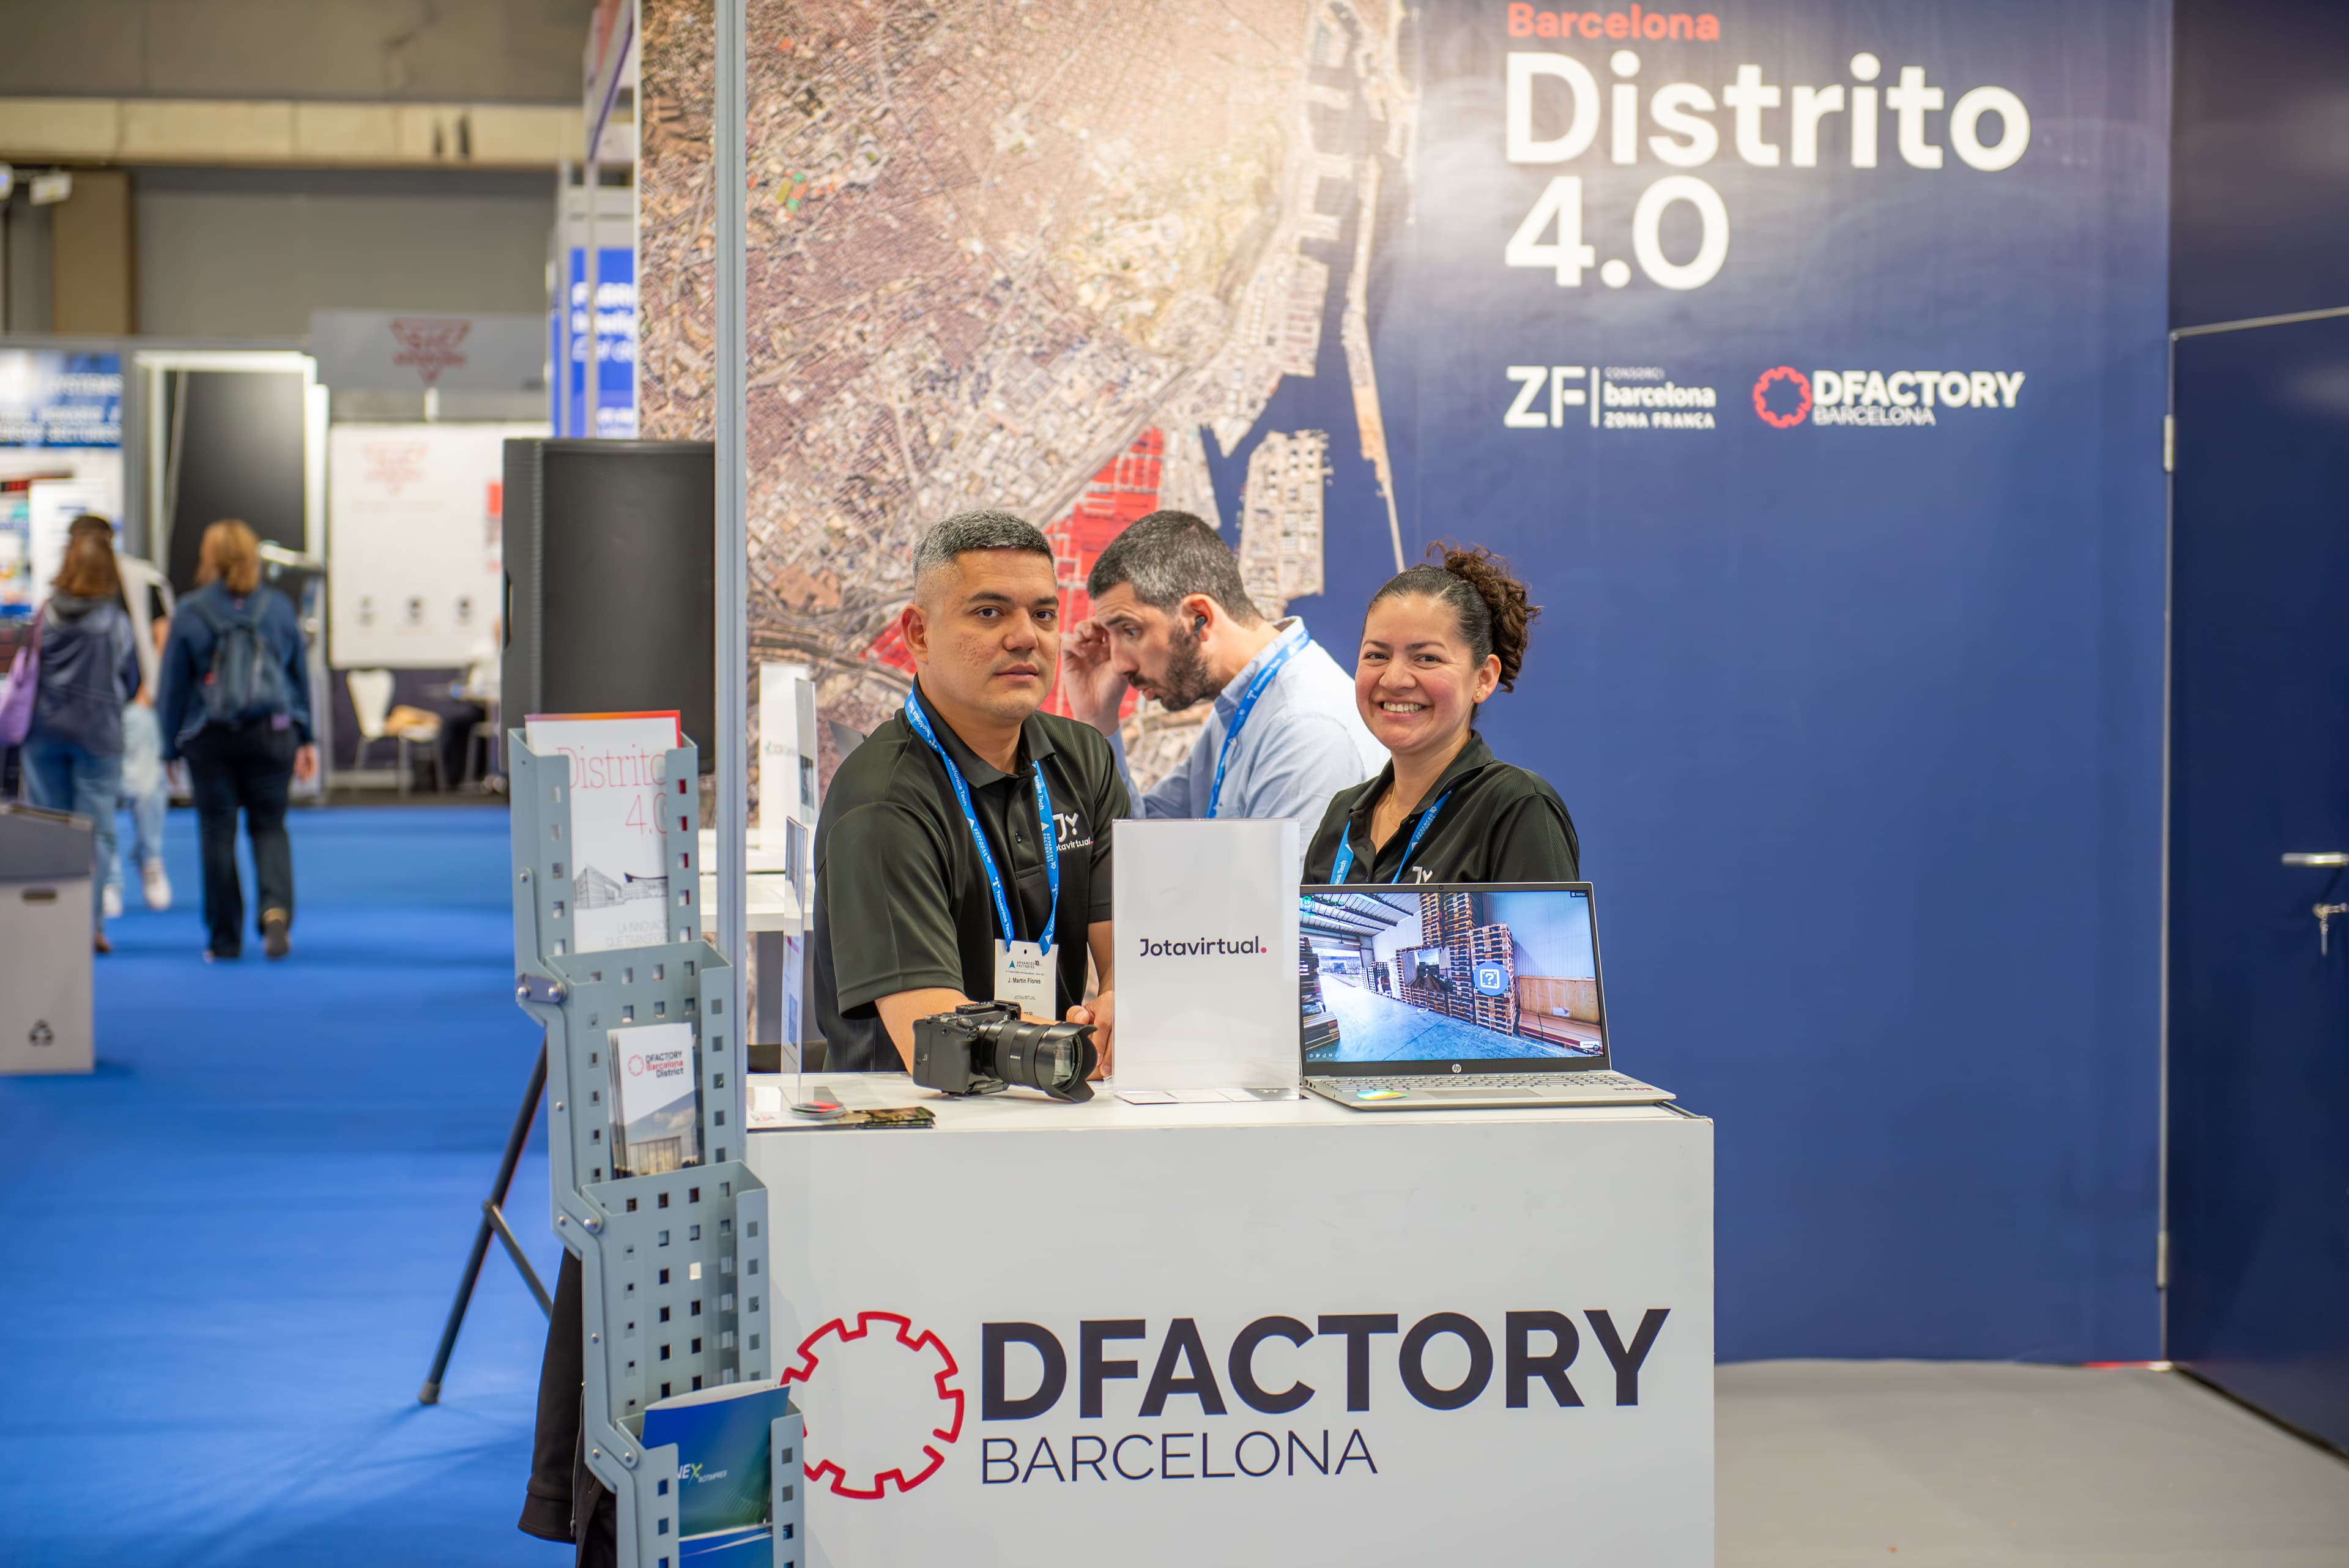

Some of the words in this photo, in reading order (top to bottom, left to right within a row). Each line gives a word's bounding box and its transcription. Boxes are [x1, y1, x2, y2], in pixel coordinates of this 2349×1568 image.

[1507, 3, 1720, 40] Barcelona
[1507, 50, 2030, 171] Distrito
[1505, 175, 1729, 290] 4.0
[1604, 367, 1665, 381] CONSORCI
[1504, 365, 1586, 428] ZF
[1603, 381, 1716, 407] barcelona
[1813, 370, 2025, 408] DFACTORY
[1603, 412, 1649, 428] ZONA
[1652, 412, 1715, 429] FRANCA
[1813, 406, 1935, 426] BARCELONA
[556, 744, 666, 789] Distrito
[1056, 837, 1094, 852] tavirtual.
[1140, 935, 1267, 957] Jotavirtual.
[645, 1050, 682, 1063] DFACTORY
[646, 1060, 683, 1071] Barcelona
[1452, 1063, 1461, 1074] hp
[656, 1068, 684, 1078] District
[982, 1308, 1671, 1421] DFACTORY
[982, 1428, 1378, 1484] BARCELONA
